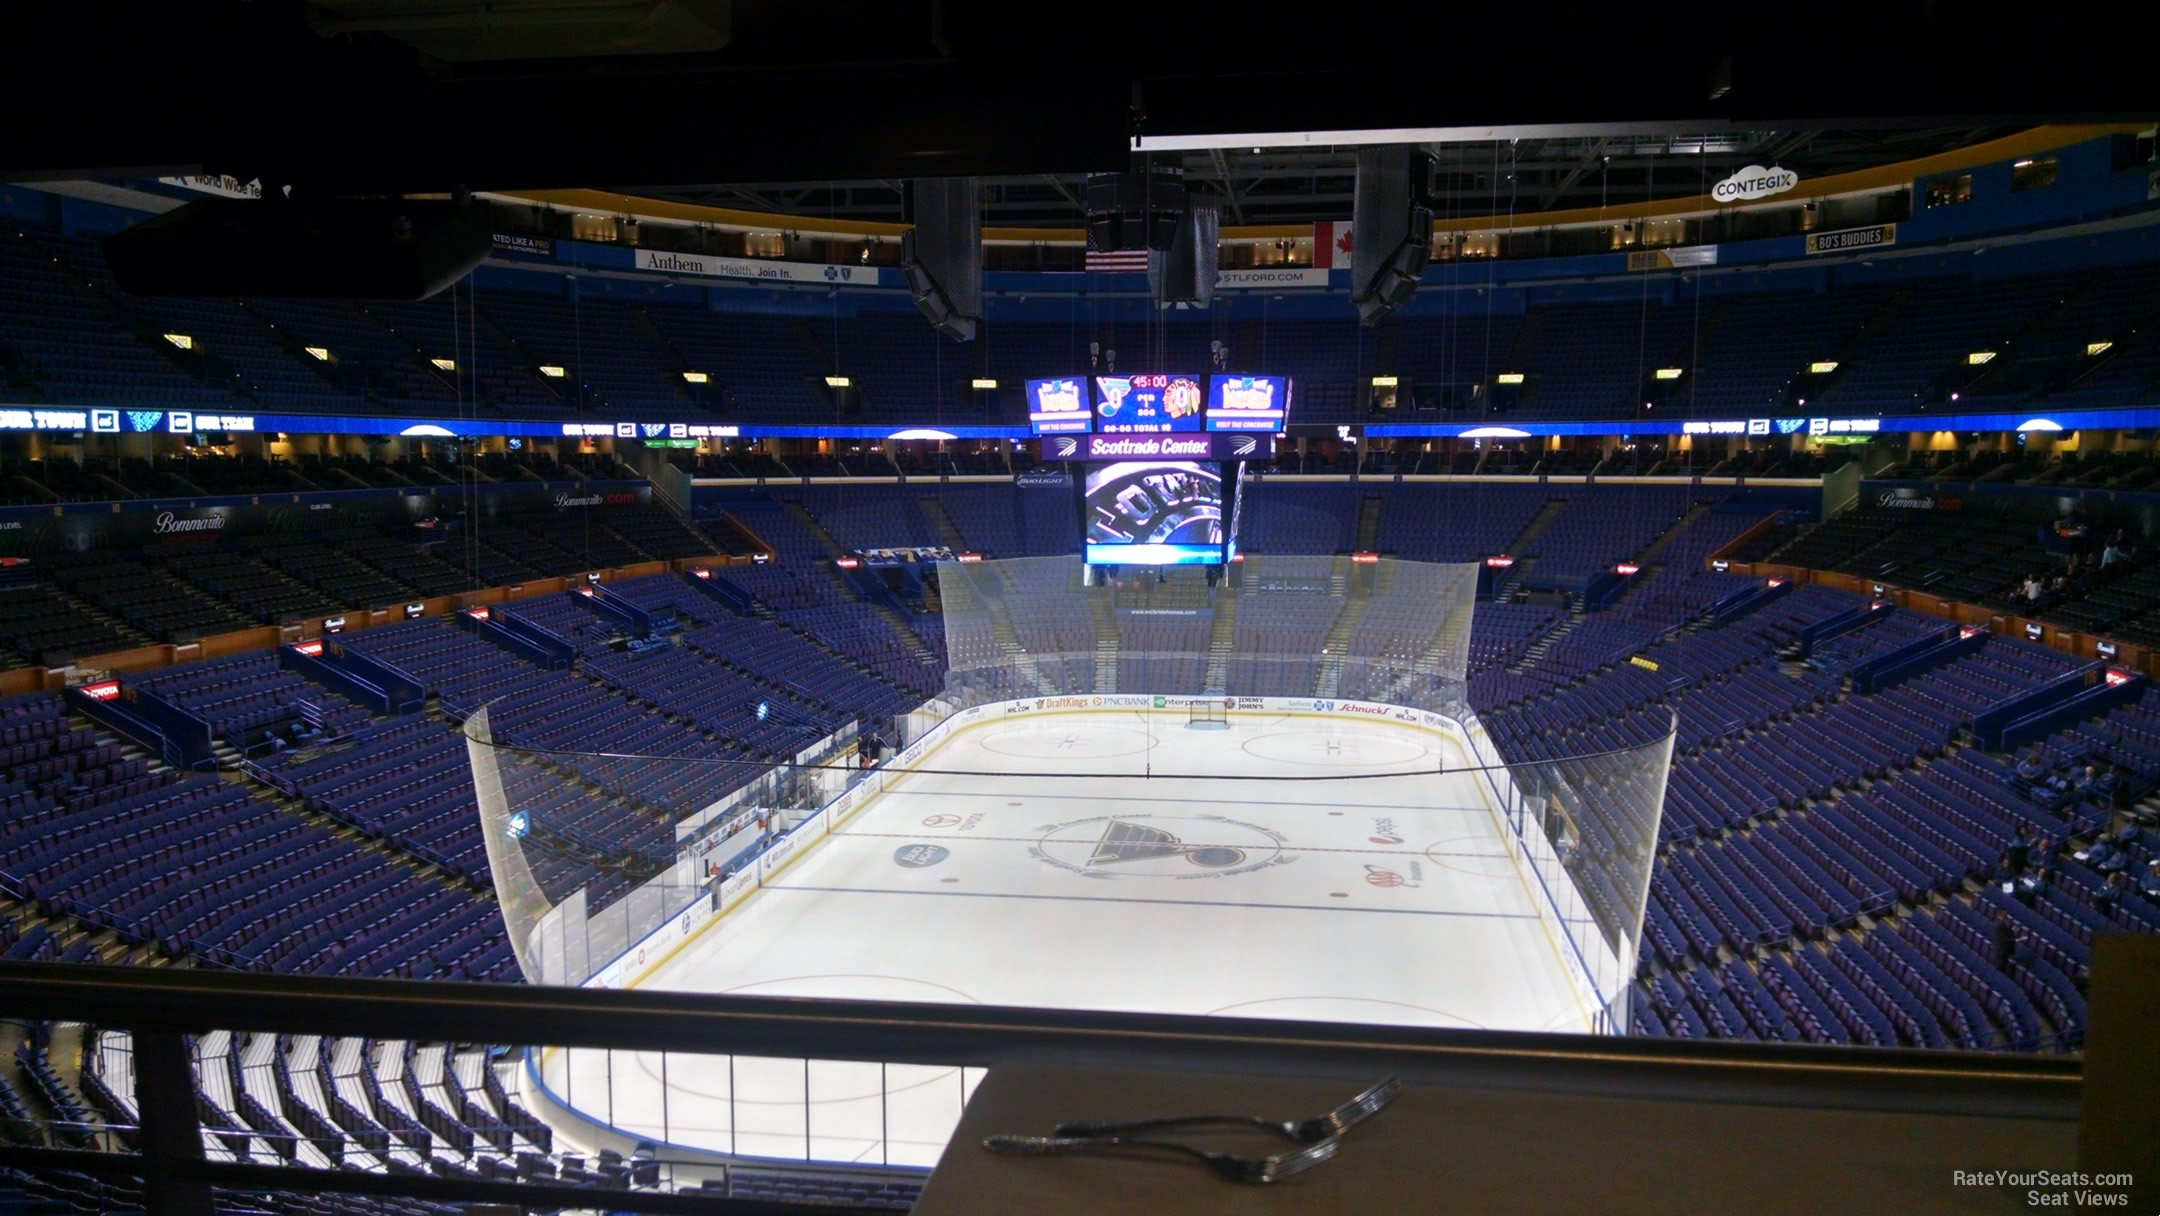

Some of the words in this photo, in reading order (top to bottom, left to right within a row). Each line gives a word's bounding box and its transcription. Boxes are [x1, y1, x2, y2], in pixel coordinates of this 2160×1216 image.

[1717, 174, 1791, 196] CONTEGIX
[512, 236, 527, 246] LIKE
[528, 239, 534, 247] A
[535, 240, 550, 249] PRO
[1819, 234, 1839, 249] BO'S
[1841, 230, 1881, 247] BUDDIES
[648, 253, 703, 273] Anthem
[720, 264, 755, 277] Health.
[758, 266, 777, 279] Join
[780, 268, 793, 279] In.
[1223, 272, 1303, 282] STLFORD.COM
[1133, 376, 1167, 388] 45:00
[1134, 424, 1159, 432] TOTAL
[1091, 438, 1160, 455] Scottrade
[4, 521, 22, 530] LEVEL
[153, 512, 225, 534] Bommarito
[1007, 705, 1030, 713] NHL.COM
[1046, 697, 1088, 709] DraftKings
[1338, 703, 1390, 715] Schnucks
[905, 742, 922, 764] GEICO
[902, 846, 924, 861] BUD
[913, 845, 939, 865] LIGHT
